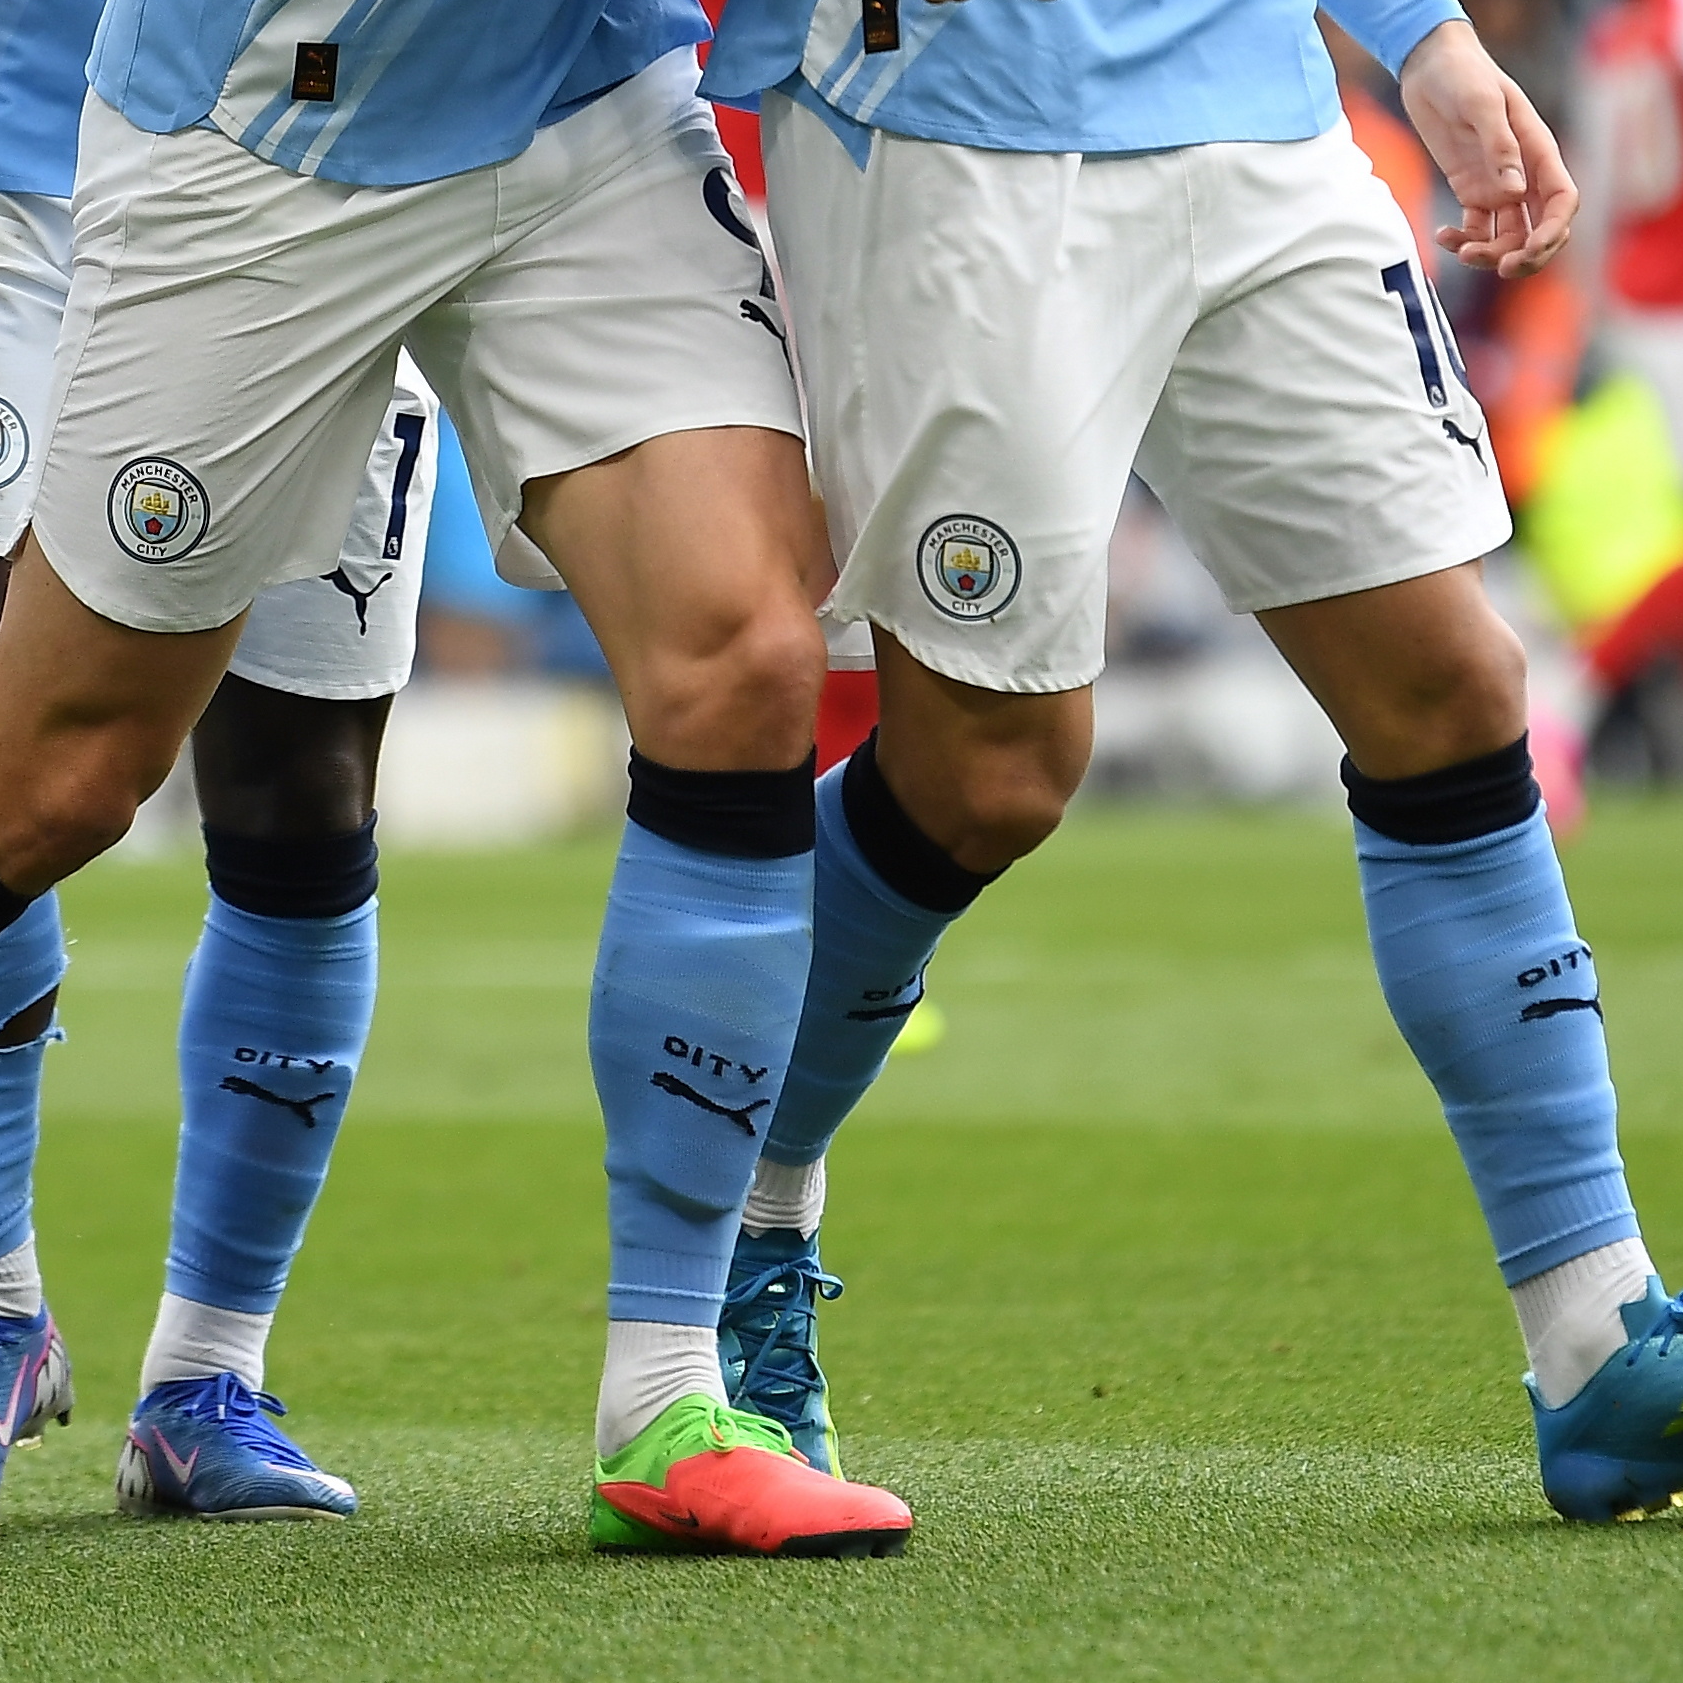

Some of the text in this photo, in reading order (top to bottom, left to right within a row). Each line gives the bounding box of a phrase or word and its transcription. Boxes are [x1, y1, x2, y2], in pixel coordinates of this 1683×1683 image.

[121, 465, 198, 504] MANCHESTER
[136, 543, 168, 556] CITY
[928, 522, 1010, 558] MANCHESTER
[952, 600, 982, 614] CITY
[234, 1047, 335, 1074] CITY
[663, 1036, 769, 1084] CITY
